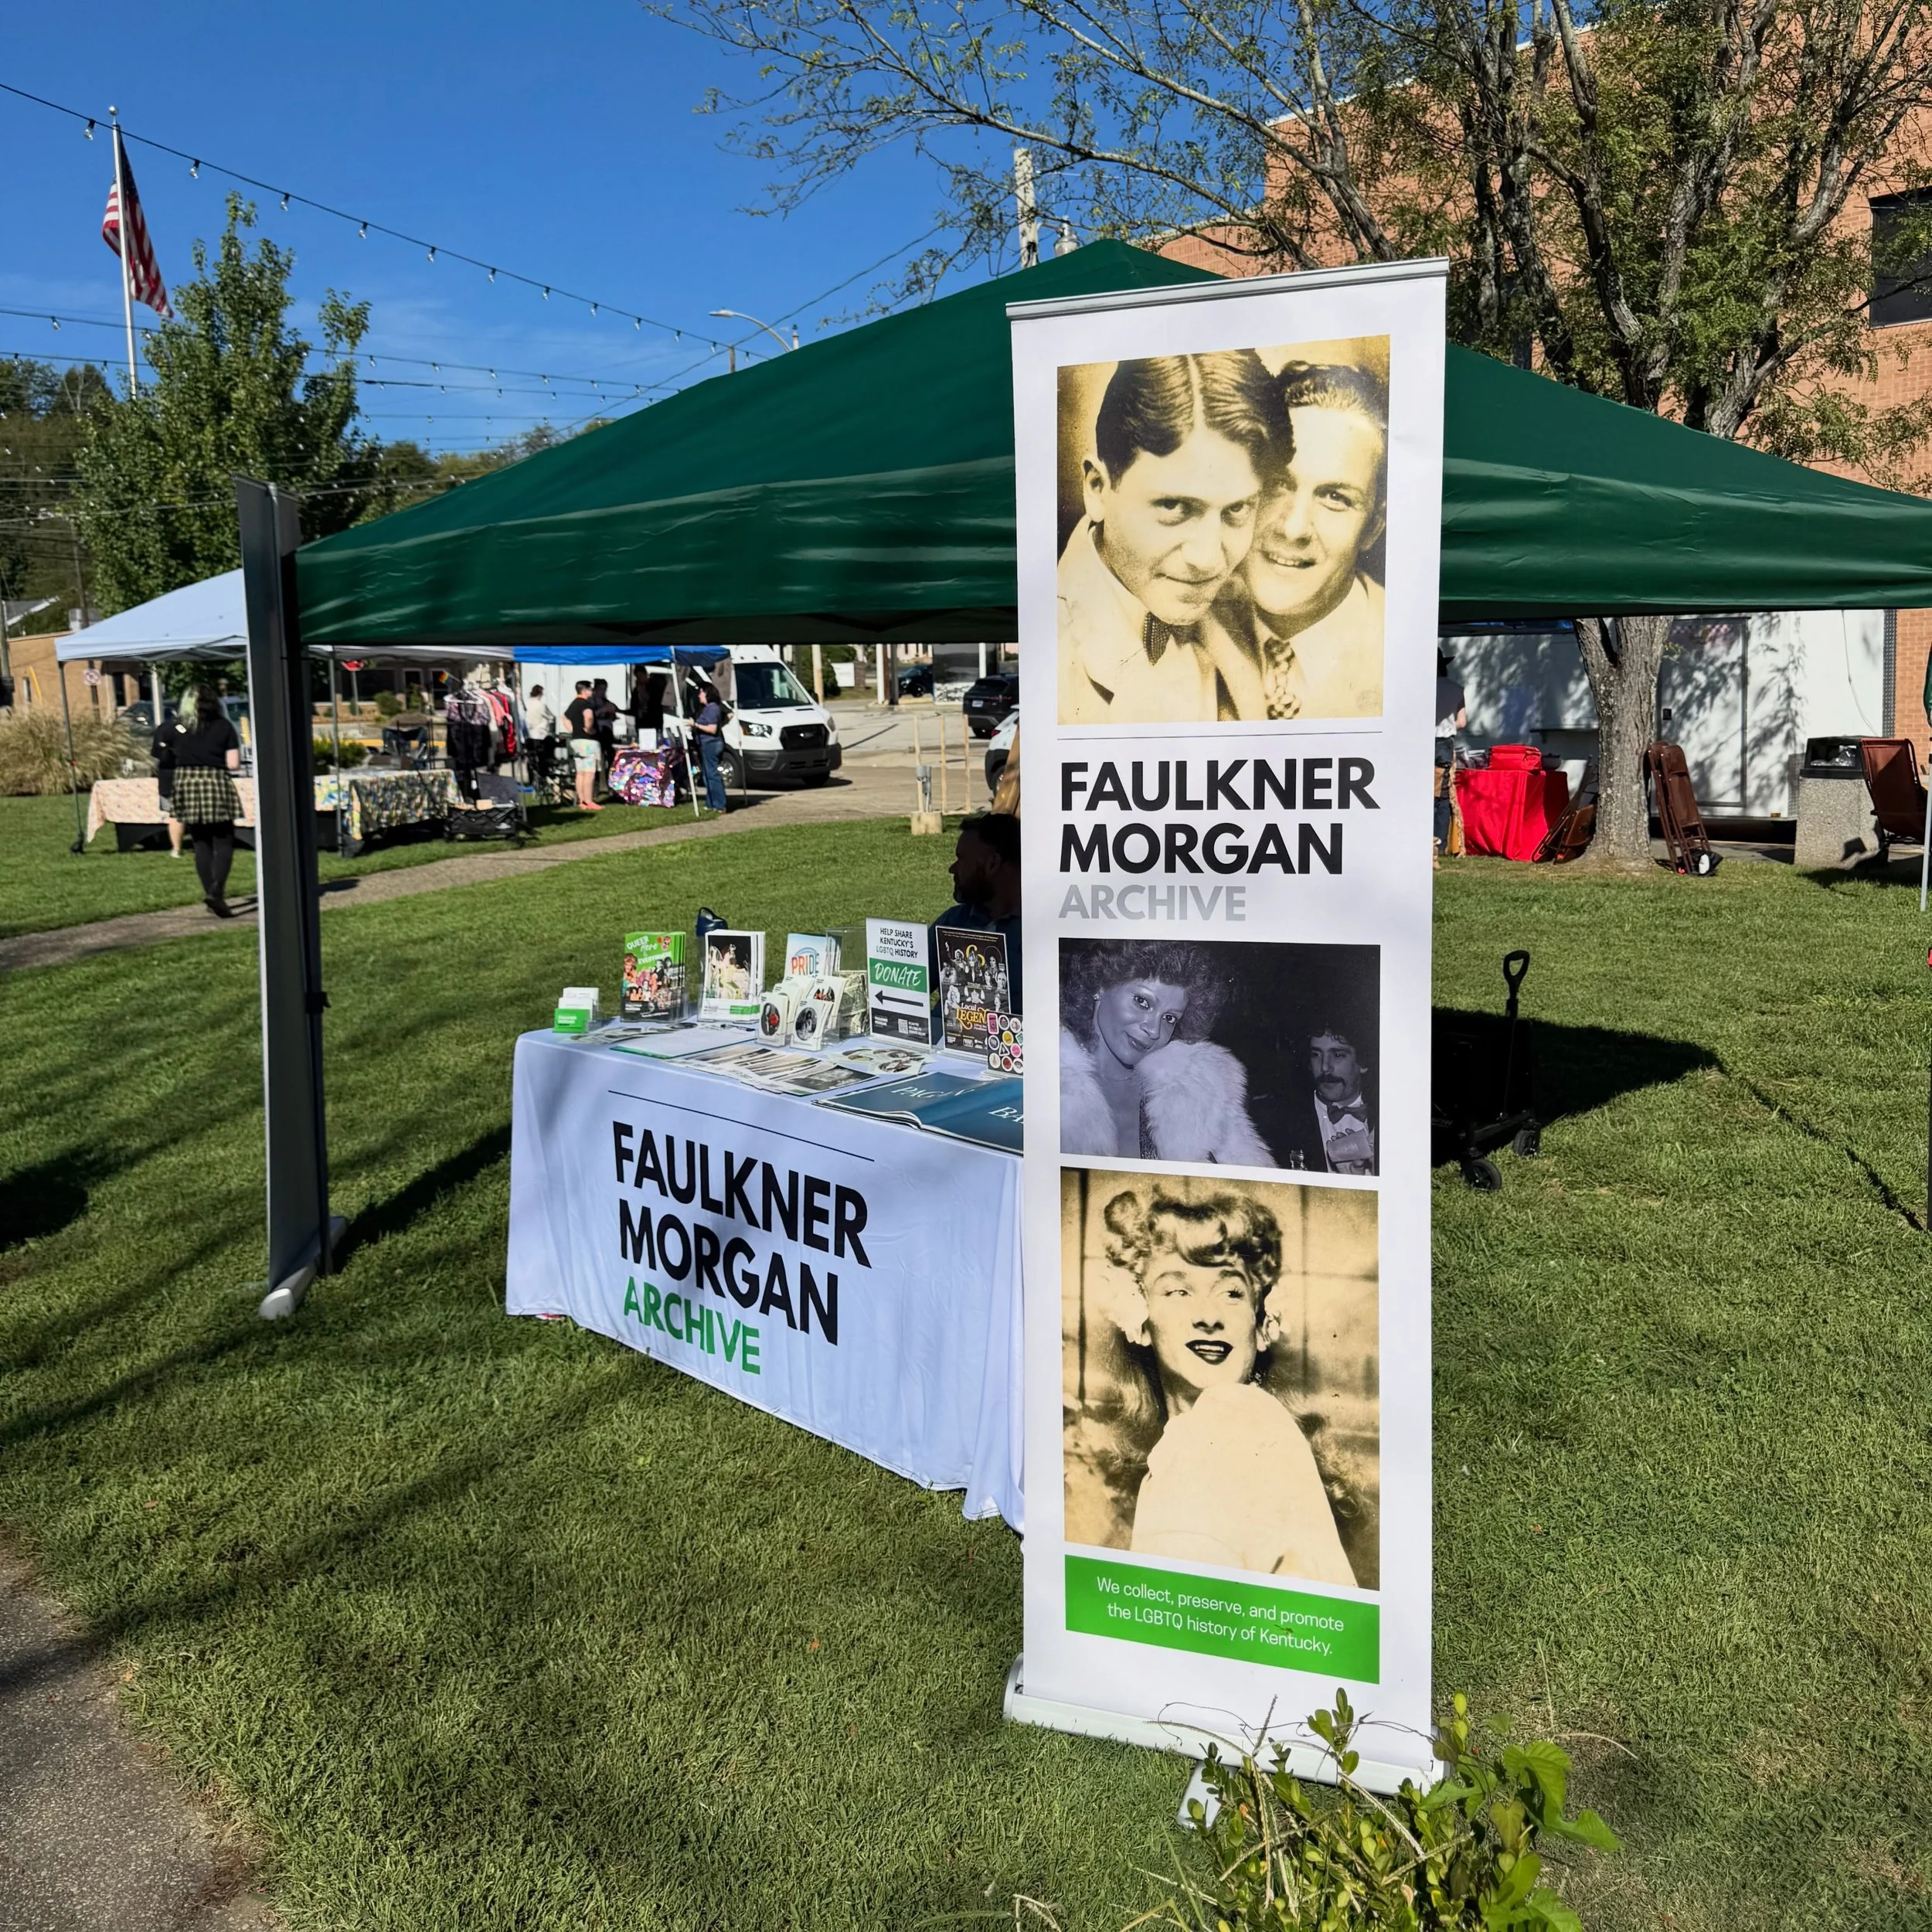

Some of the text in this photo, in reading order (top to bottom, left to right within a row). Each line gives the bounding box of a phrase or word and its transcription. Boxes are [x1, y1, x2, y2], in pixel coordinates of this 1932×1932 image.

[1061, 757, 1381, 811] FAULKNER
[1060, 822, 1343, 875] MORGAN
[1058, 884, 1247, 921] ARCHIVE
[627, 935, 649, 950] QUEER
[879, 937, 913, 949] KENTUCKY'S
[880, 927, 913, 939] HELP SHARE
[791, 953, 819, 975] PRIDE
[876, 945, 919, 958] LGBTQ HISTORY
[875, 962, 922, 987] DONATE
[956, 1007, 988, 1030] LEGEN
[961, 1002, 977, 1012] Local
[988, 1106, 1024, 1124] BA
[613, 1121, 872, 1269] FAULKNER
[619, 1198, 838, 1346] MORGAN
[624, 1275, 761, 1375] ARCHIVE
[1096, 1575, 1345, 1632] We collect, preserve, and promote
[1107, 1603, 1333, 1657] the LGBTQ history of Kentucky.
